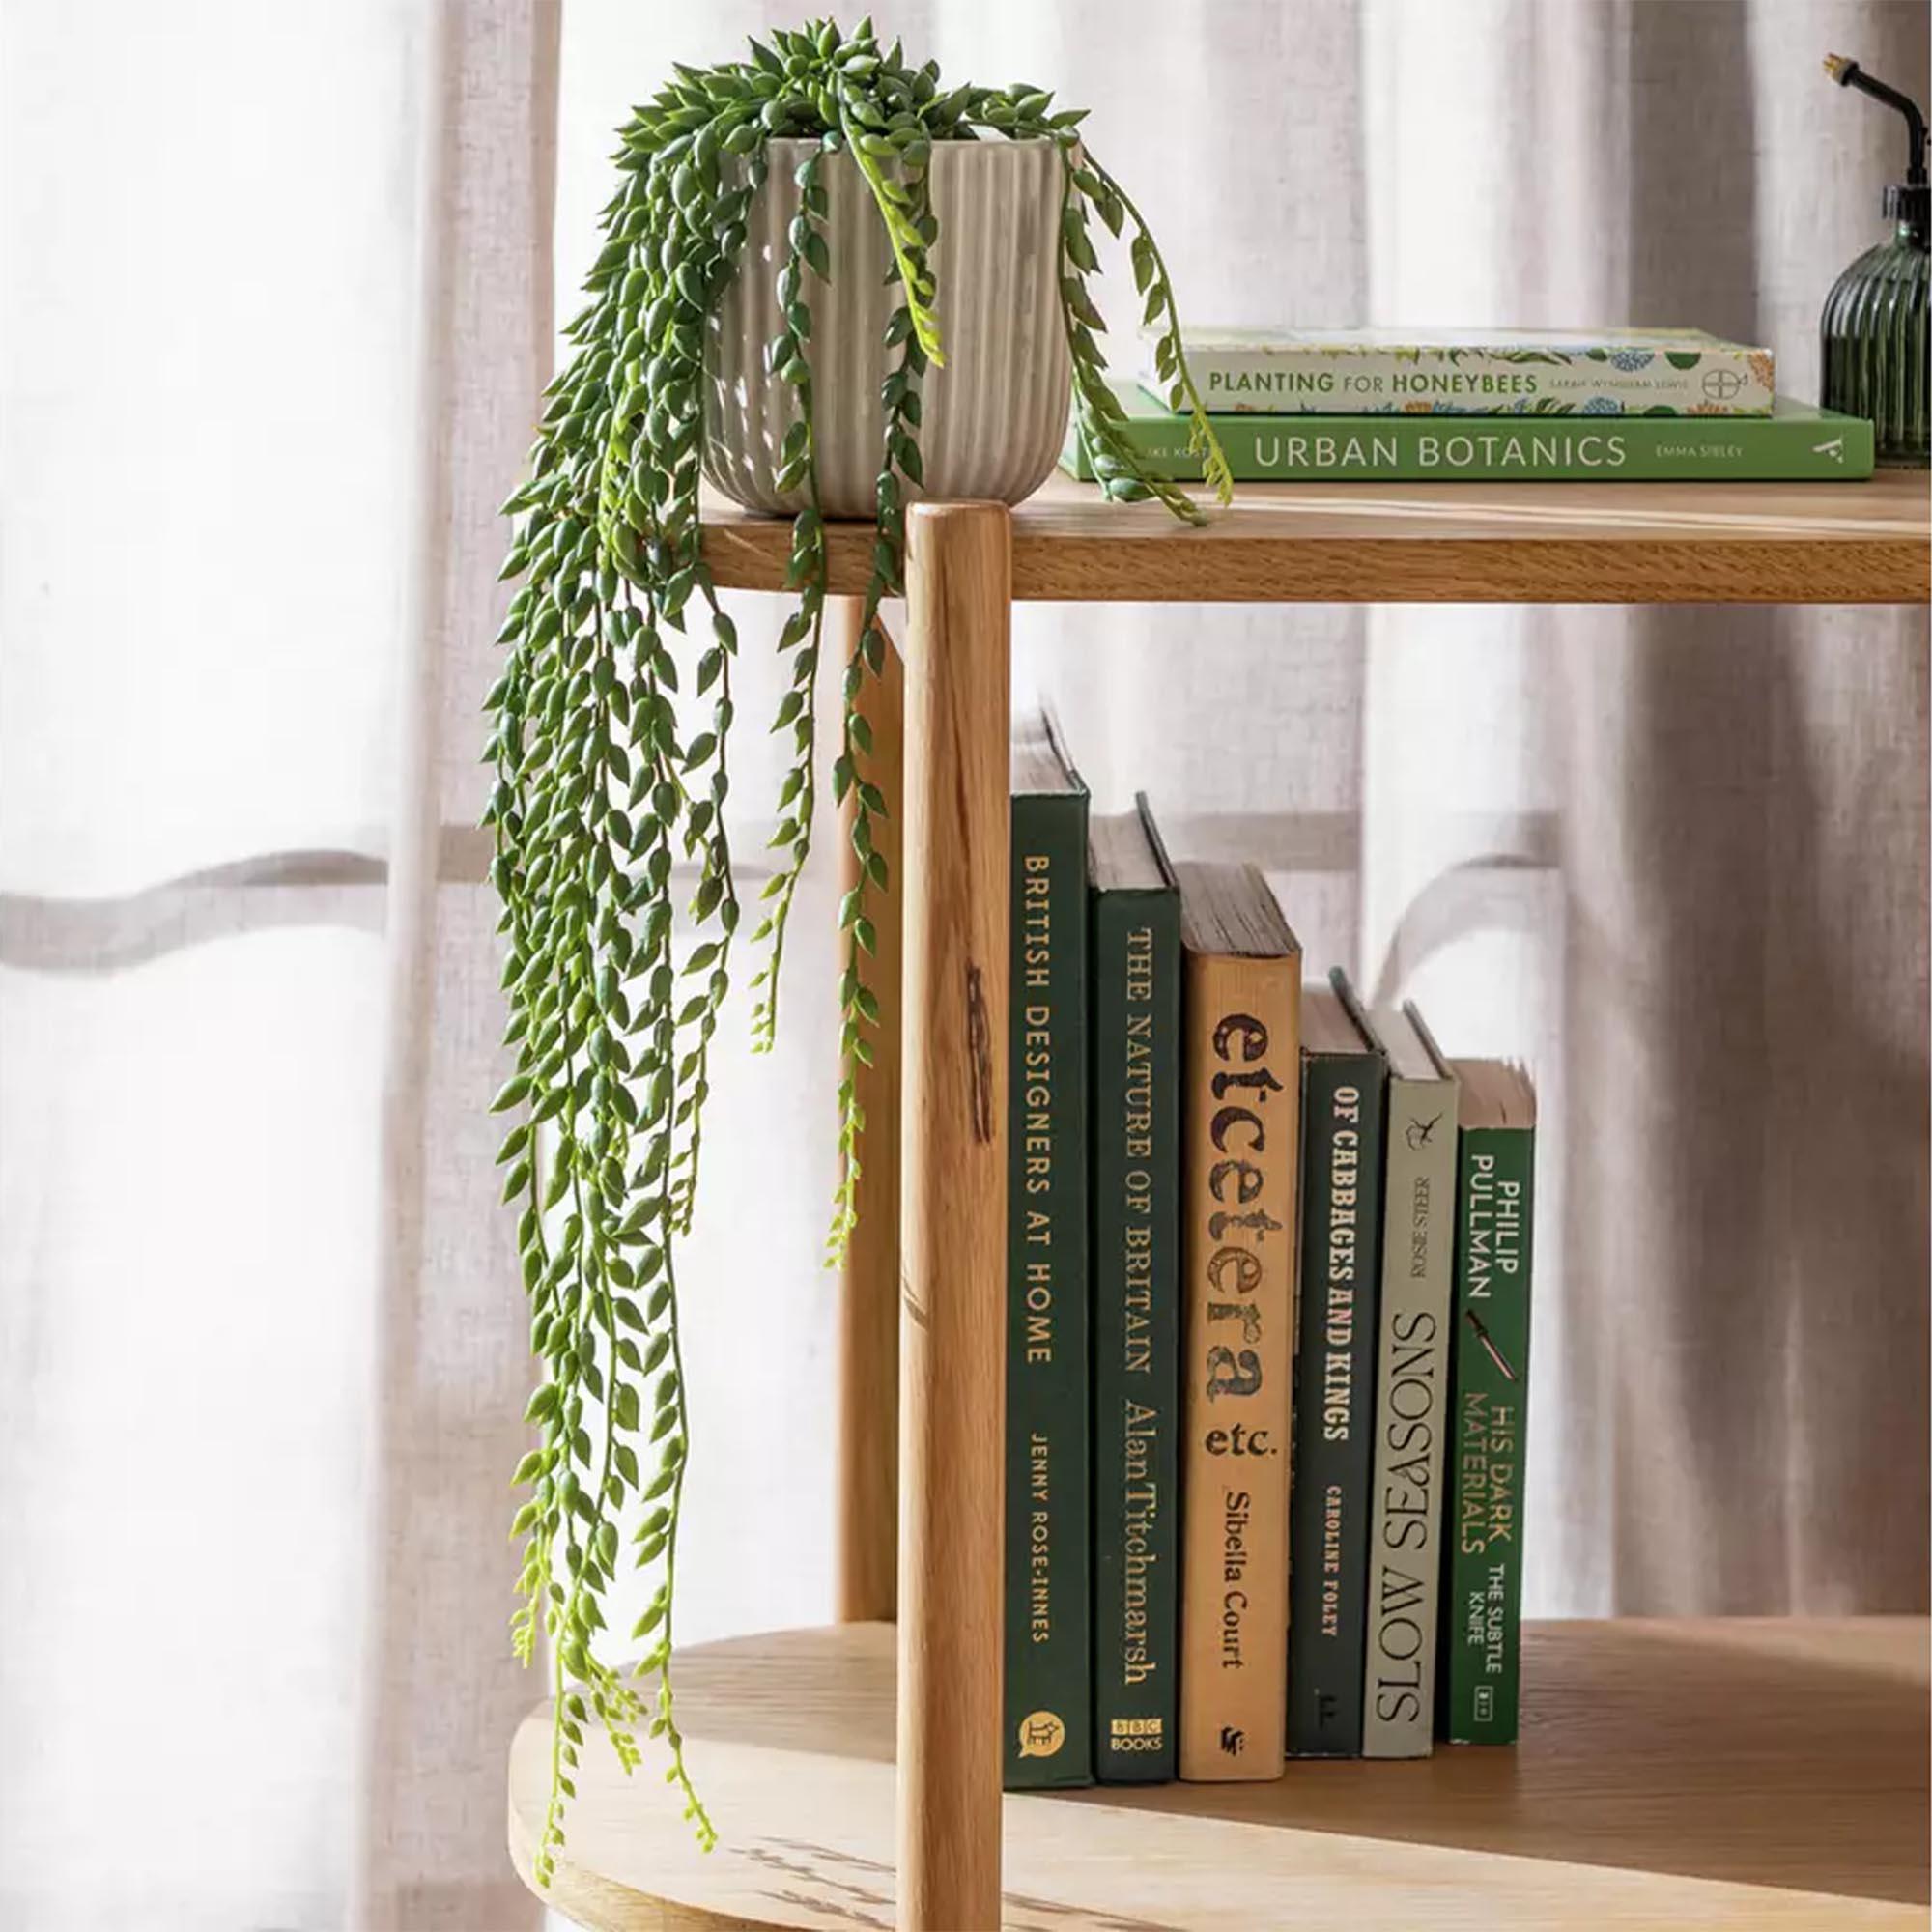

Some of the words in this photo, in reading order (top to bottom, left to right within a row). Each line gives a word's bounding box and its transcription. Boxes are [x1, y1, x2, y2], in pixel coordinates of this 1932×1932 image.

[1210, 372, 1333, 392] PLANTING
[1344, 376, 1382, 393] FOR
[1393, 374, 1537, 393] HONEYBEES
[1256, 437, 1396, 466] URBAN
[1419, 437, 1625, 466] BOTANICS
[1656, 444, 1696, 457] EMMA
[1025, 857, 1049, 985] BRITISH
[1127, 928, 1151, 1000] THE
[1026, 1007, 1050, 1193] DESIGNERS
[1126, 1014, 1151, 1156] NATURE
[1334, 1087, 1359, 1122] OF
[1027, 1211, 1050, 1245] AT
[1126, 1171, 1151, 1213] OF
[1207, 1013, 1283, 1402] etcetera
[1328, 1130, 1359, 1281] CABBAGES
[1413, 1177, 1430, 1228] STEER
[1468, 1154, 1494, 1298] PULLMAN
[1495, 1180, 1520, 1274] PHILIP
[1410, 1231, 1428, 1279] ROSIE
[1028, 1264, 1051, 1362] HOME
[1125, 1227, 1151, 1372] BRITAIN
[1326, 1287, 1354, 1347] AND
[1323, 1352, 1351, 1441] KINGS
[1382, 1311, 1436, 1550] SEASONS
[1488, 1407, 1513, 1452] HIS
[1032, 1434, 1047, 1500] JENNY
[1126, 1400, 1156, 1480] Alan
[1206, 1424, 1277, 1456] etc.
[1461, 1393, 1489, 1554] MATERIALS
[1225, 1492, 1250, 1582] Sibella
[1325, 1486, 1341, 1572] CAROLINE
[1487, 1464, 1512, 1541] DARK
[1125, 1483, 1156, 1684] Titchmarsh
[1322, 1581, 1338, 1635] FOLEY
[1468, 1591, 1485, 1647] KNIFE
[1488, 1564, 1504, 1599] THE
[1223, 1591, 1247, 1668] Court
[1376, 1565, 1425, 1723] SLOW
[1486, 1605, 1504, 1673] SUBTLE
[1111, 1738, 1162, 1750] BOOKS
